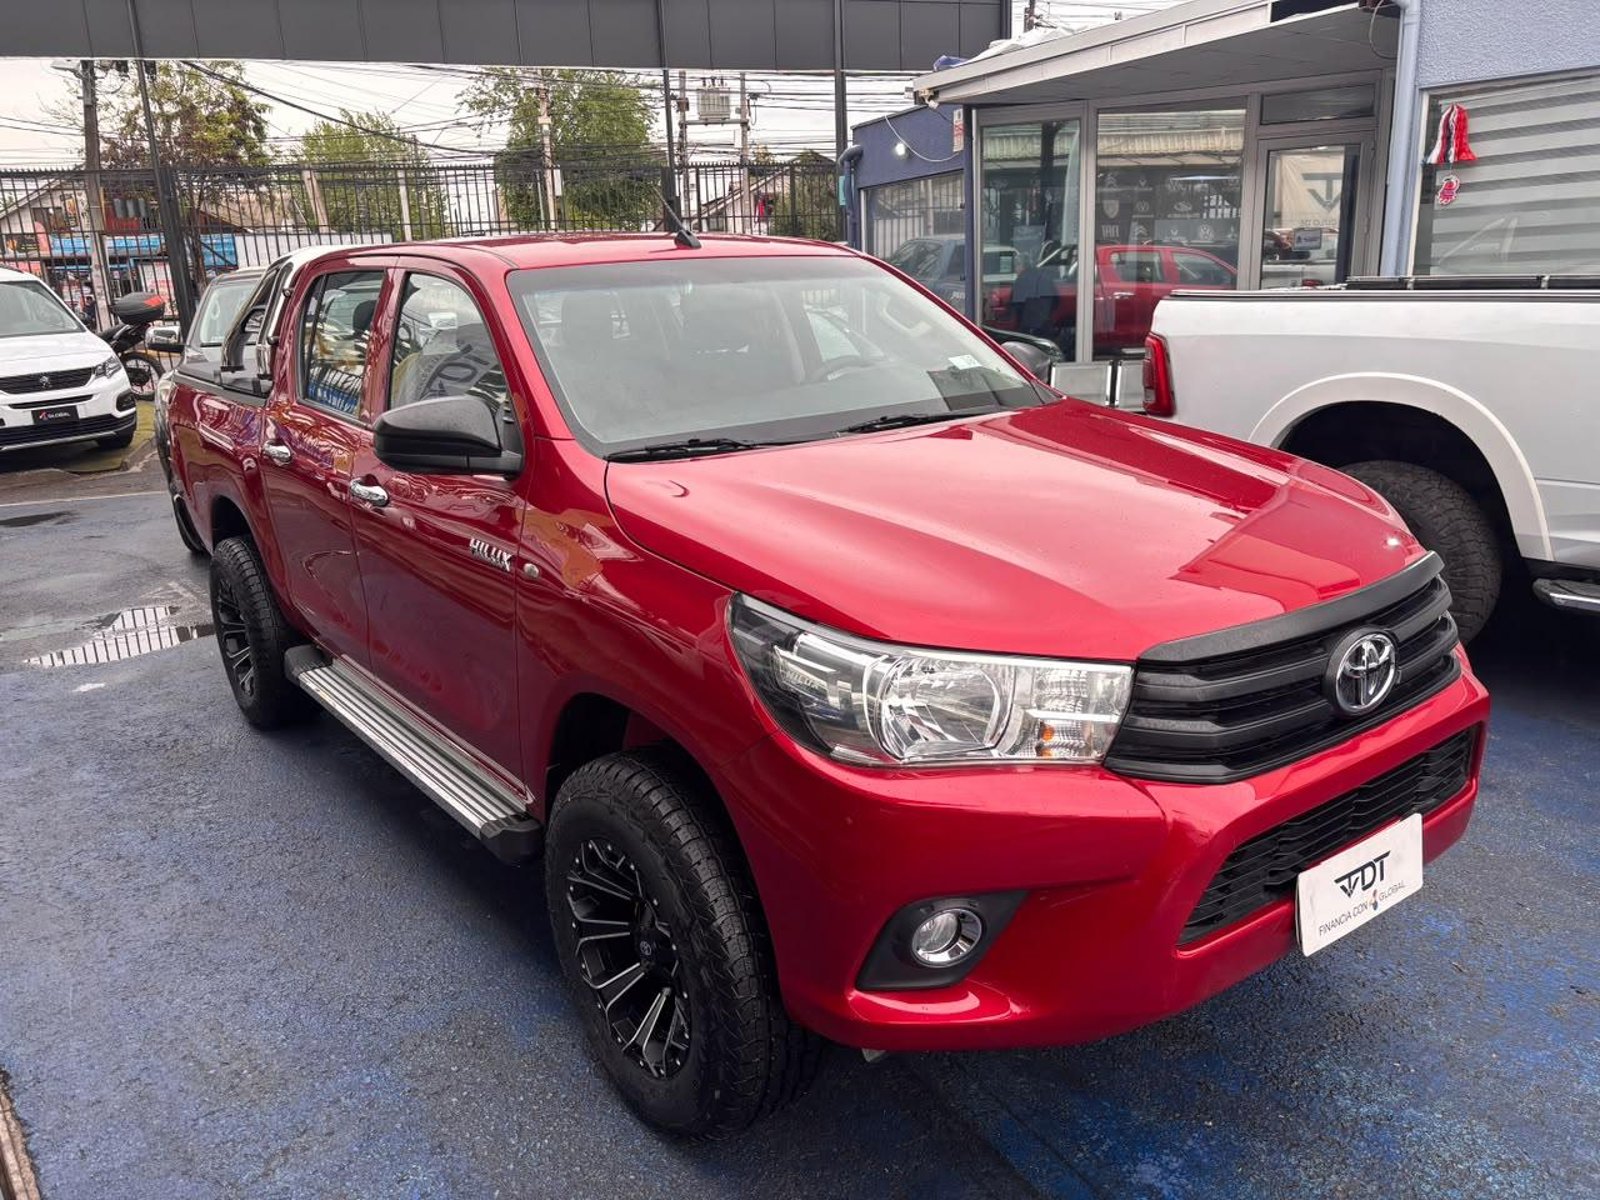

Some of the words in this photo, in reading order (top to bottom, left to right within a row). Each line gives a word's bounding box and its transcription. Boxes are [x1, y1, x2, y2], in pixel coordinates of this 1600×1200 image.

[469, 538, 512, 572] HILUX
[1318, 910, 1352, 937] FINANCIA
[1353, 901, 1369, 918] CON
[1379, 879, 1406, 902] GLOBAL
